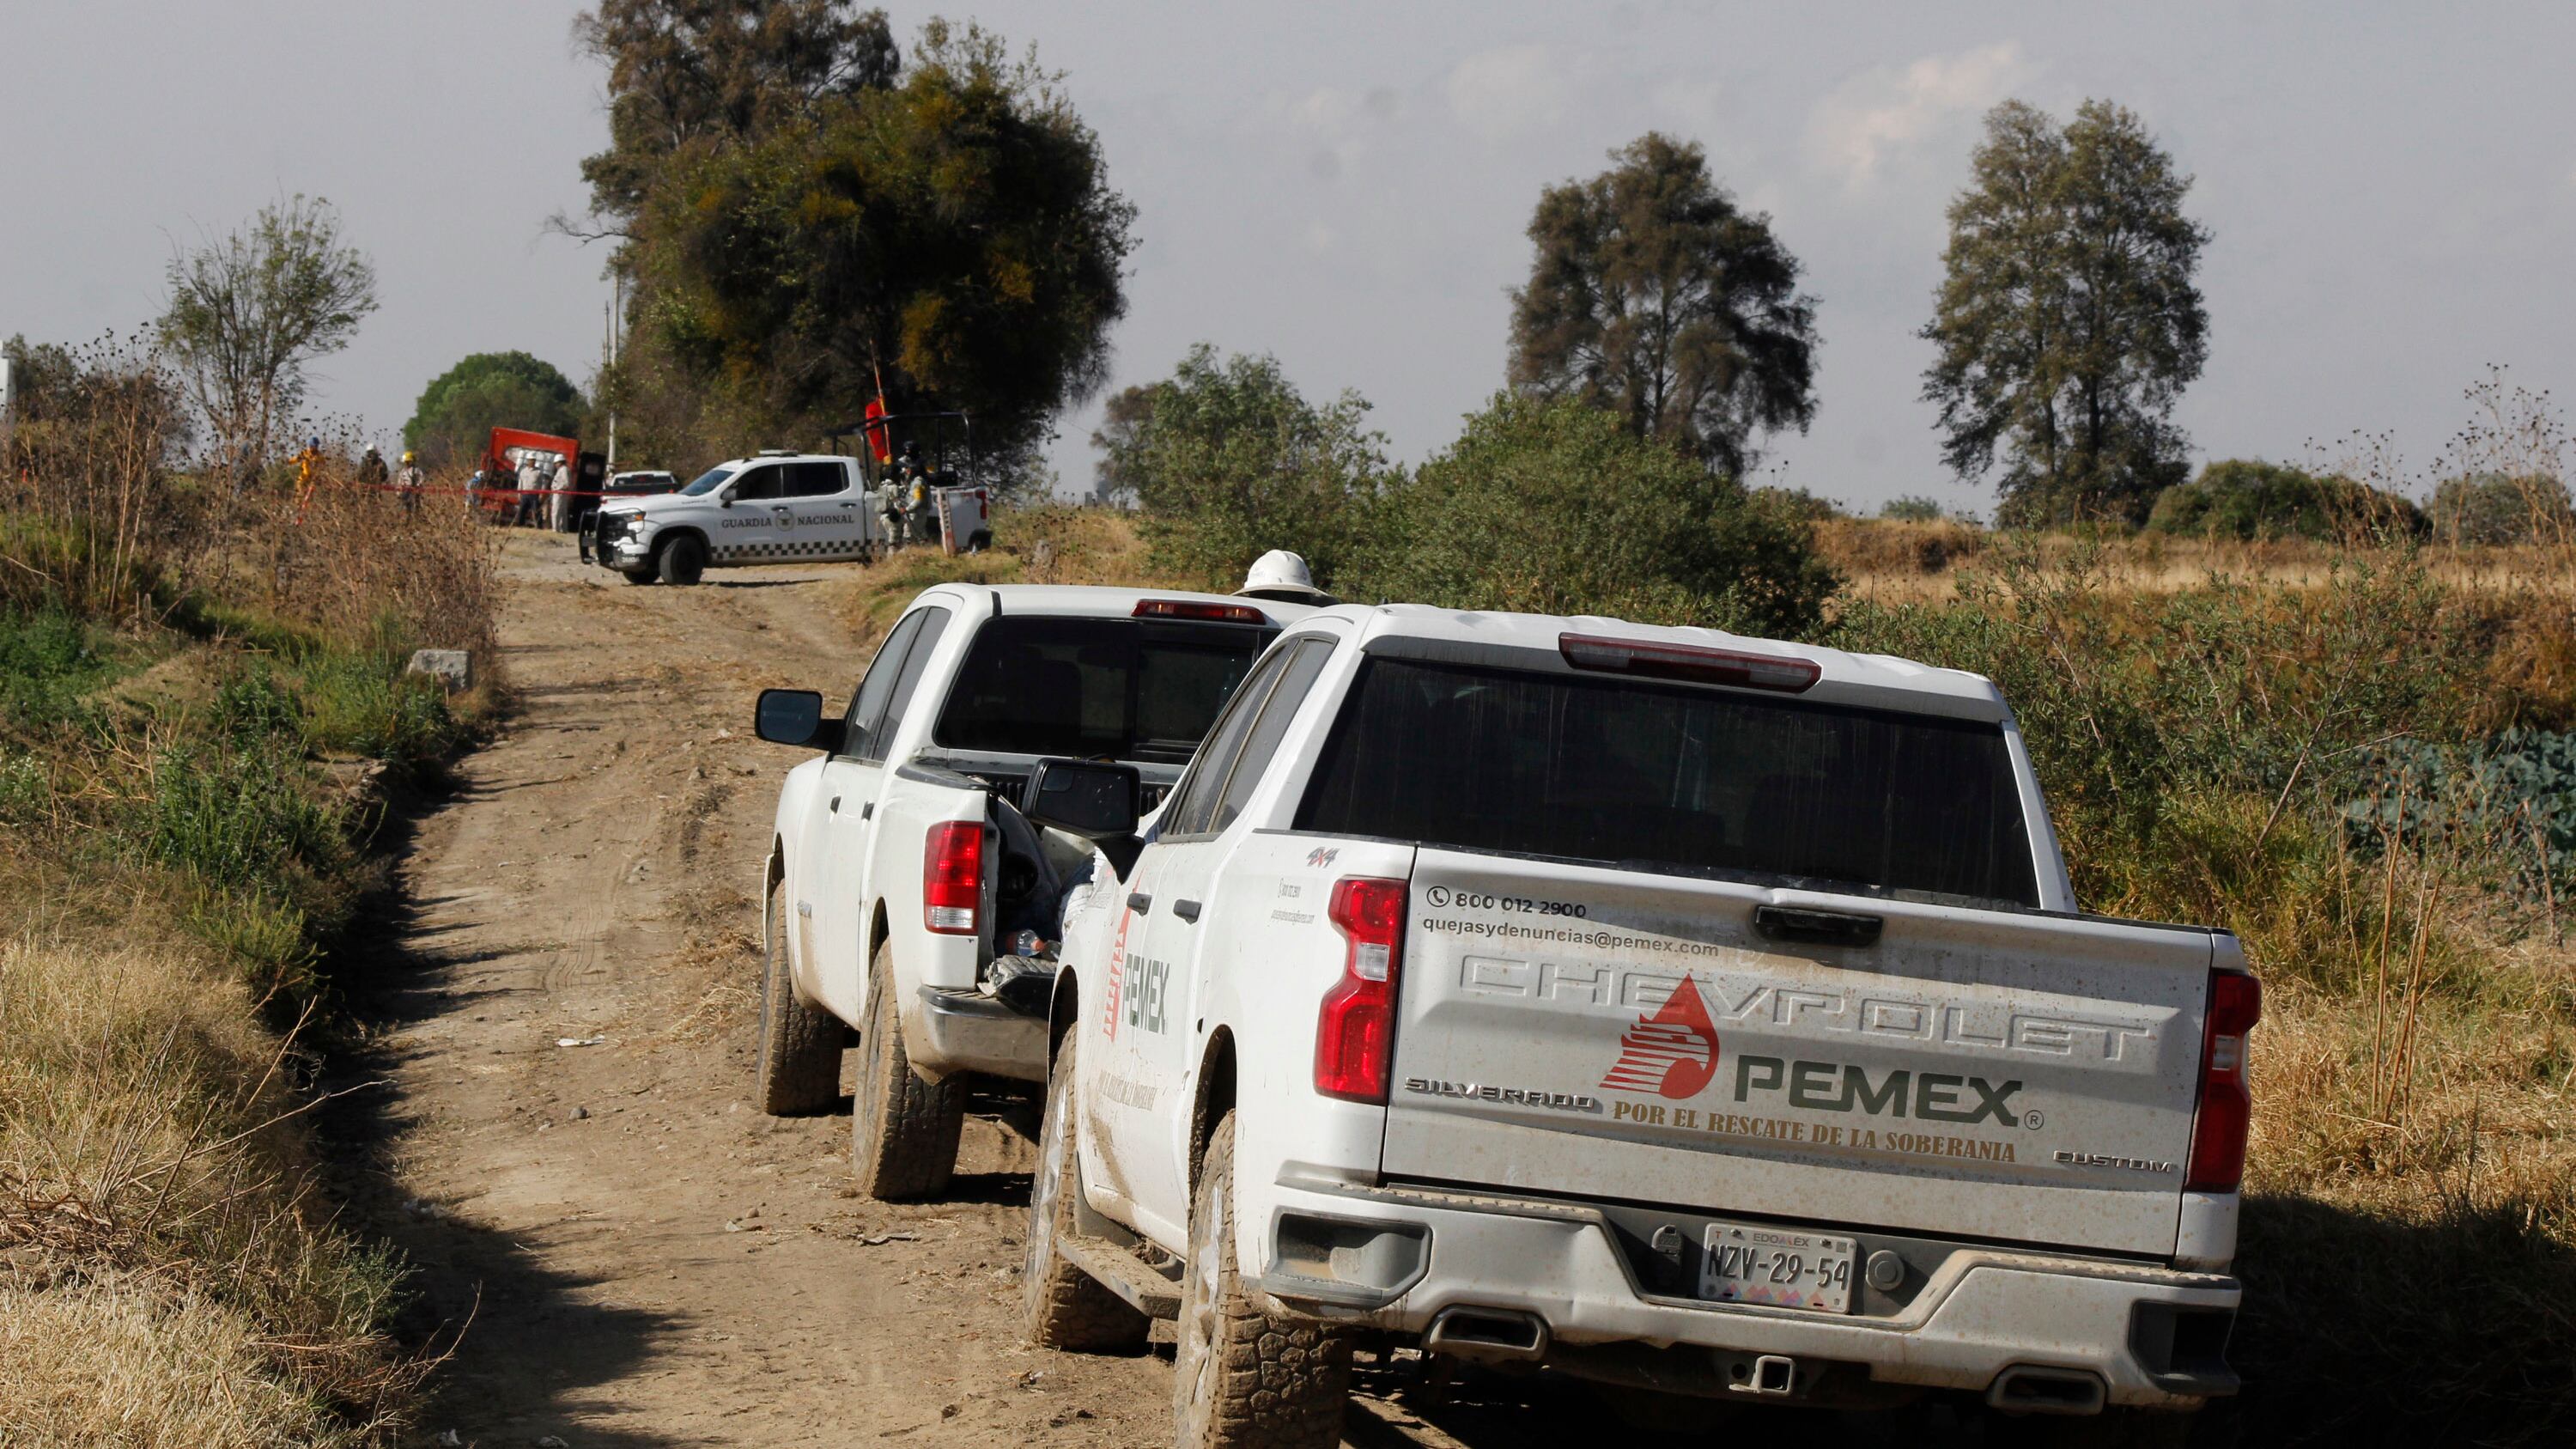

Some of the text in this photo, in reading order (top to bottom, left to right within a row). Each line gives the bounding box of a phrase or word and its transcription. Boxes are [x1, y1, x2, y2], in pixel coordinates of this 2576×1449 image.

[721, 514, 854, 529] GUARDIA NACIONAL
[1455, 892, 1587, 918] 800 012 2900
[1423, 916, 1718, 957] quejasydenuncias@pemex.com
[1121, 953, 1170, 1035] PEMEX
[1460, 954, 2148, 1061] CHEVROLET
[1405, 1077, 1596, 1110] SILVERADO
[1734, 1054, 2022, 1127] PEMEX
[1613, 1101, 2016, 1162] POR EL RESCATE DE LA SOBERANIA
[2053, 1149, 2172, 1172] CUSTOM
[1707, 1243, 1849, 1291] NZV-29-54
